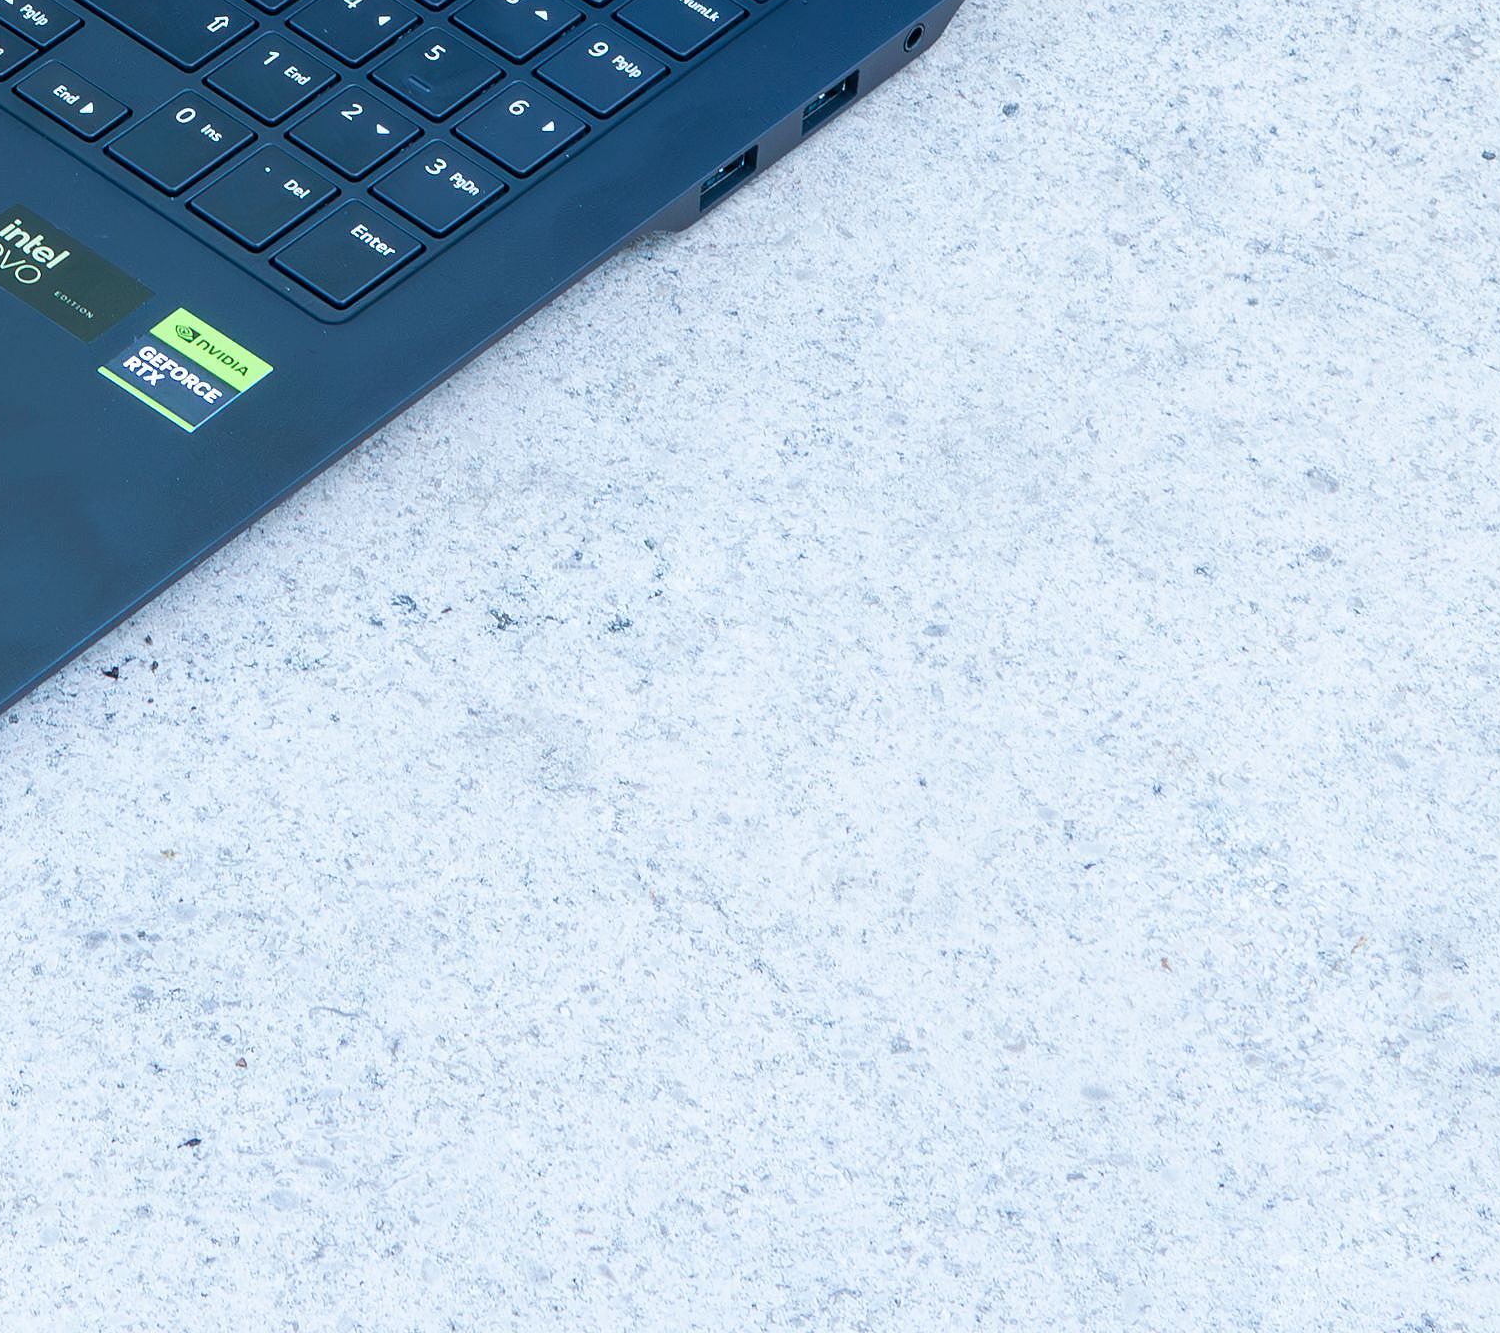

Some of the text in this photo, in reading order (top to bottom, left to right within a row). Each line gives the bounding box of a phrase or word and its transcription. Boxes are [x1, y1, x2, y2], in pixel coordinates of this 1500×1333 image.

[20, 4, 48, 25] PgUp
[0, 219, 70, 269] intel
[351, 224, 395, 255] Enter
[55, 291, 93, 318] EDITION
[123, 356, 165, 387] RTX
[137, 346, 223, 405] GEFORCE
